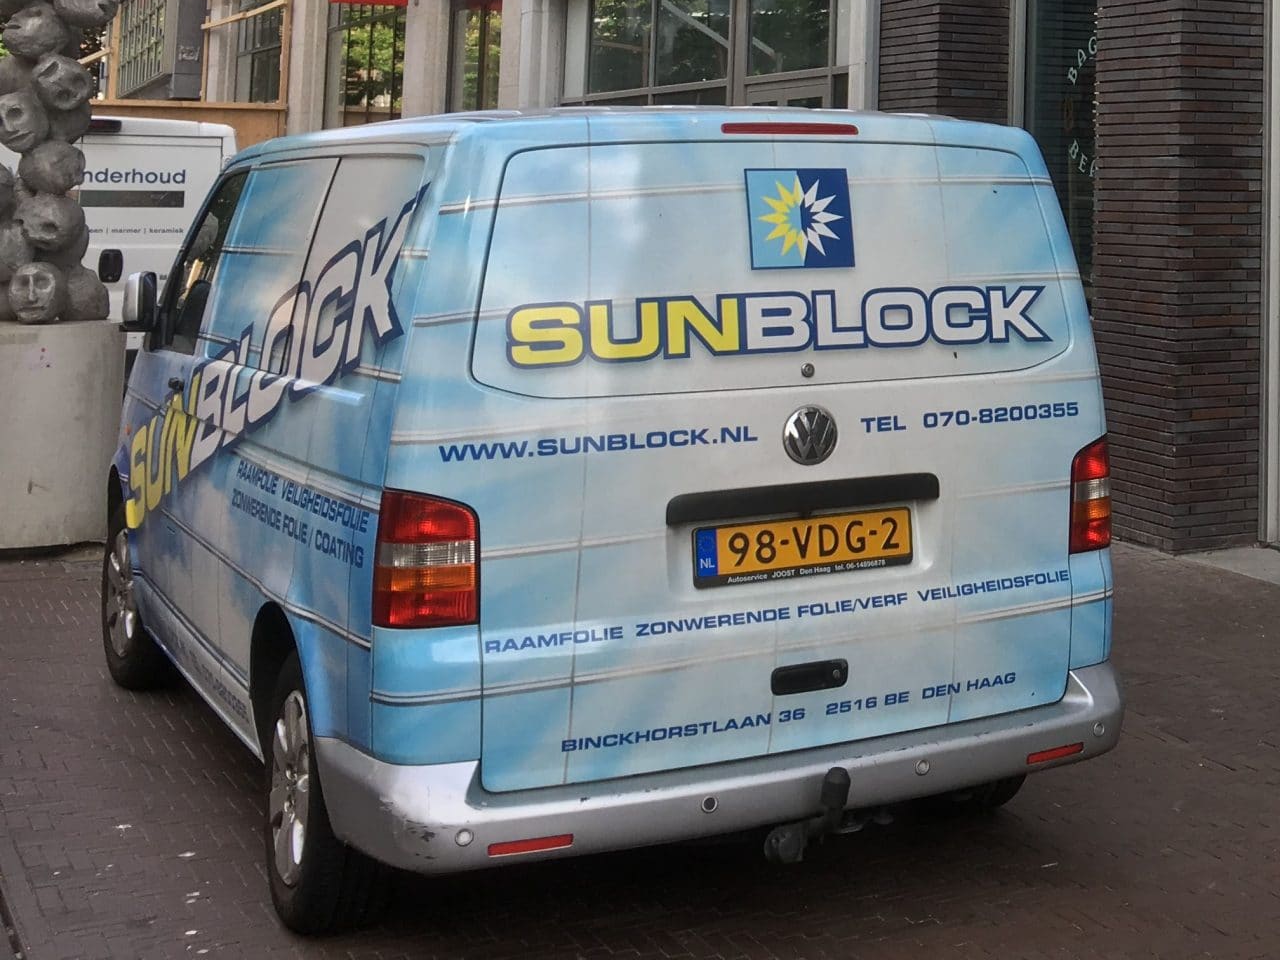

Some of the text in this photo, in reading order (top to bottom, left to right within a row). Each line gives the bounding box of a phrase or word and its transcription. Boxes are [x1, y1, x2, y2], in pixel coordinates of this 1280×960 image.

[125, 182, 430, 529] SUNBLOCK
[505, 285, 1053, 370] SUNBLOCK
[438, 401, 1079, 463] WWW.SUNBLOCK.NL TEL 070-8200355
[236, 460, 370, 533] RAAMFOLIE VEILIGHEIDSFOLIE
[282, 514, 307, 544] FOLIE
[315, 529, 365, 569] COATING
[700, 558, 715, 569] NL
[727, 573, 768, 584] Autoservice
[772, 569, 796, 579] JOOST
[799, 567, 813, 576] Den
[813, 565, 831, 576] Haag
[728, 517, 900, 567] 98-VDG-2
[485, 626, 624, 654] RAAMFOLIE
[635, 606, 790, 638] ZONWERENDE
[917, 570, 1070, 602] VEILIGHEIDSFOLIE
[561, 671, 1017, 753] BINCKHORSTLAAN 36 2516 BE DEN HAAG
